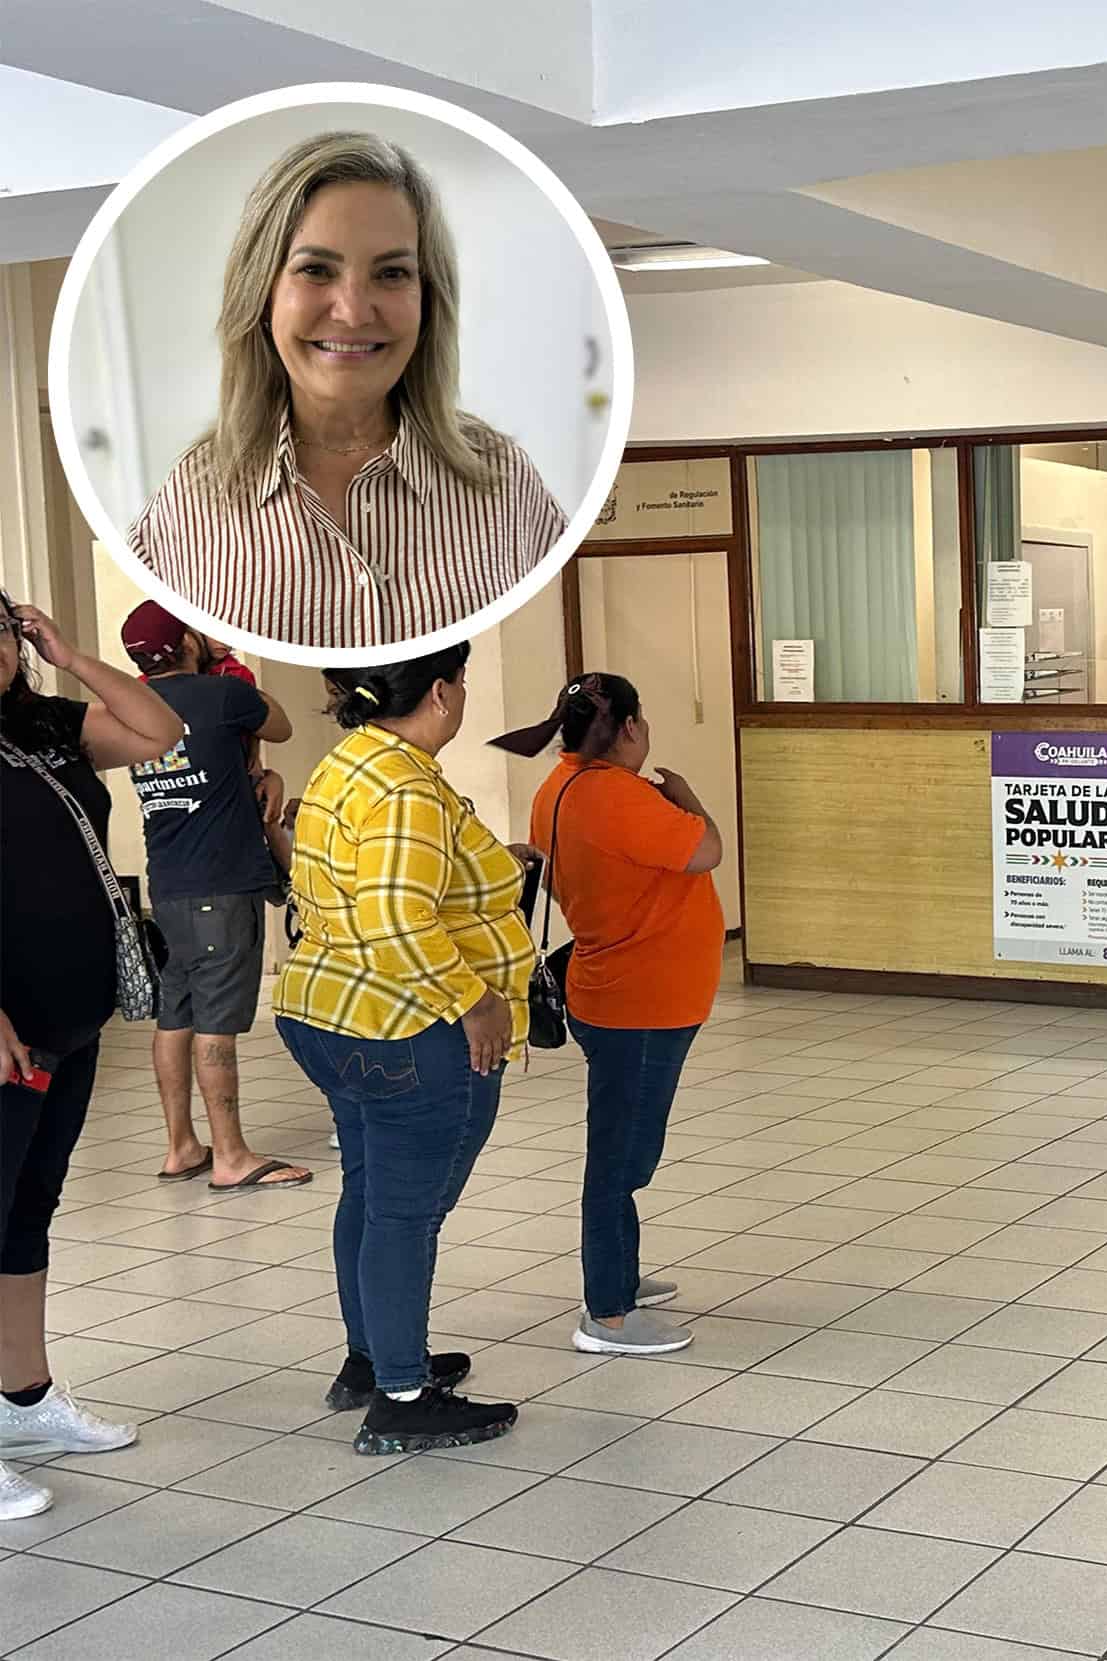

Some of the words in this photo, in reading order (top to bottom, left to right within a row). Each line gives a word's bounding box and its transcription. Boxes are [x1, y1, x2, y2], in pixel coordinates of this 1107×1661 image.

[642, 502, 672, 510] Fomento
[1034, 742, 1107, 761] COAHUILA
[1005, 783, 1067, 797] TARJETA
[1071, 785, 1091, 797] DE
[1006, 875, 1067, 886] BENEFICIARIOS:
[1059, 947, 1085, 957] LLAMA
